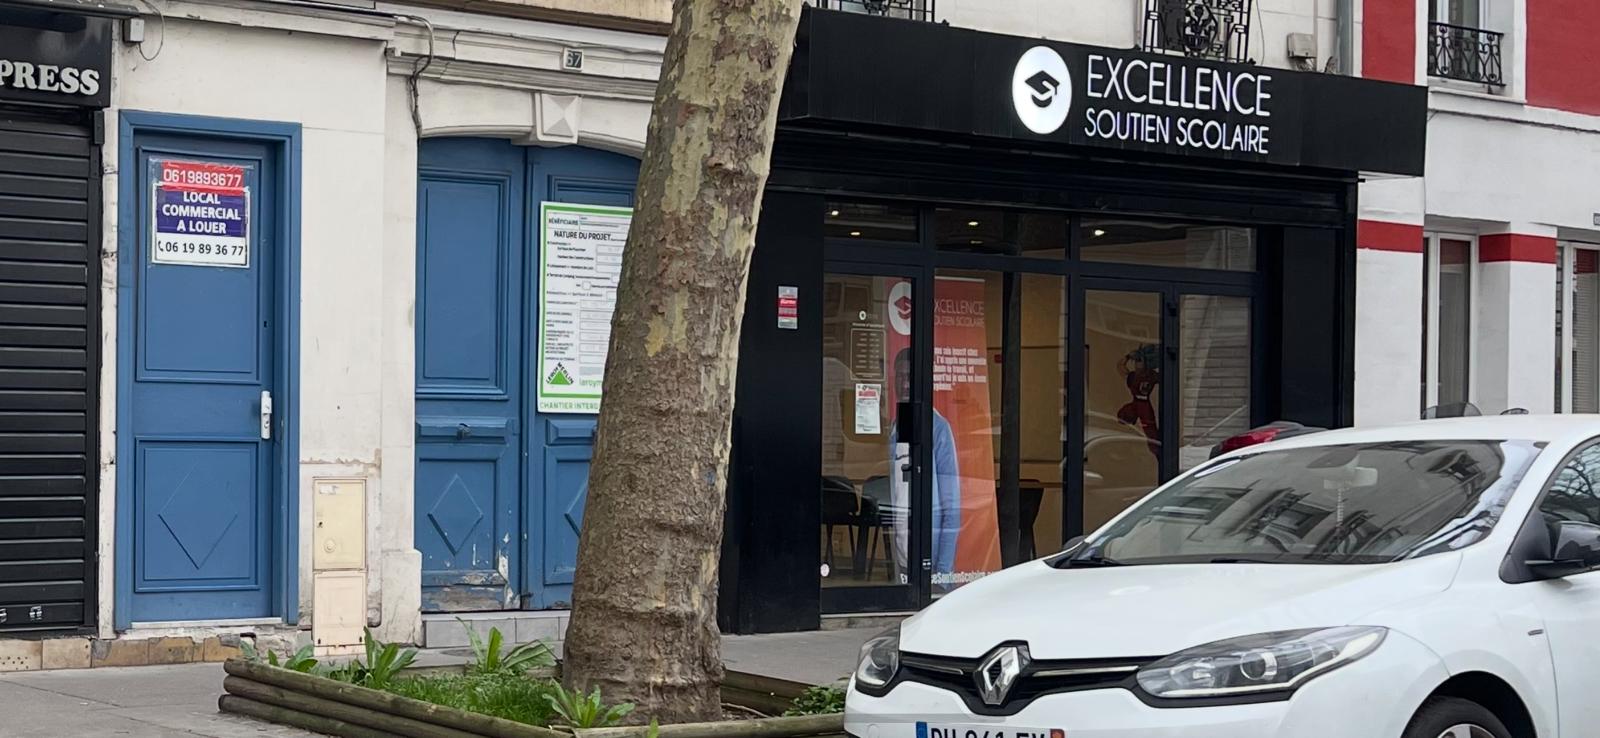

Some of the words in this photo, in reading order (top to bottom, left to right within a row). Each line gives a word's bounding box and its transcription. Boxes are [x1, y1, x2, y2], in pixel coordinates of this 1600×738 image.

[567, 51, 581, 67] 67
[0, 59, 100, 96] PRESS
[1087, 54, 1272, 117] EXCELLENCE
[1084, 108, 1169, 145] SOUTIEN
[1175, 117, 1270, 154] SCOLAIRE
[163, 168, 242, 187] 0619893677
[183, 191, 221, 205] LOCAL
[162, 204, 242, 220] COMMERCIAL
[176, 219, 186, 232] A
[189, 220, 227, 234] LOUER
[554, 230, 578, 240] NATURE
[578, 231, 588, 240] DU
[588, 232, 611, 241] PROJET
[165, 241, 179, 253] 06
[182, 242, 195, 254] 19
[198, 243, 212, 255] 89
[215, 244, 228, 256] 36
[231, 245, 244, 257] 77
[933, 298, 985, 316] XCELLENCE
[540, 401, 573, 410] CHANTIER
[574, 402, 599, 410] INTERD
